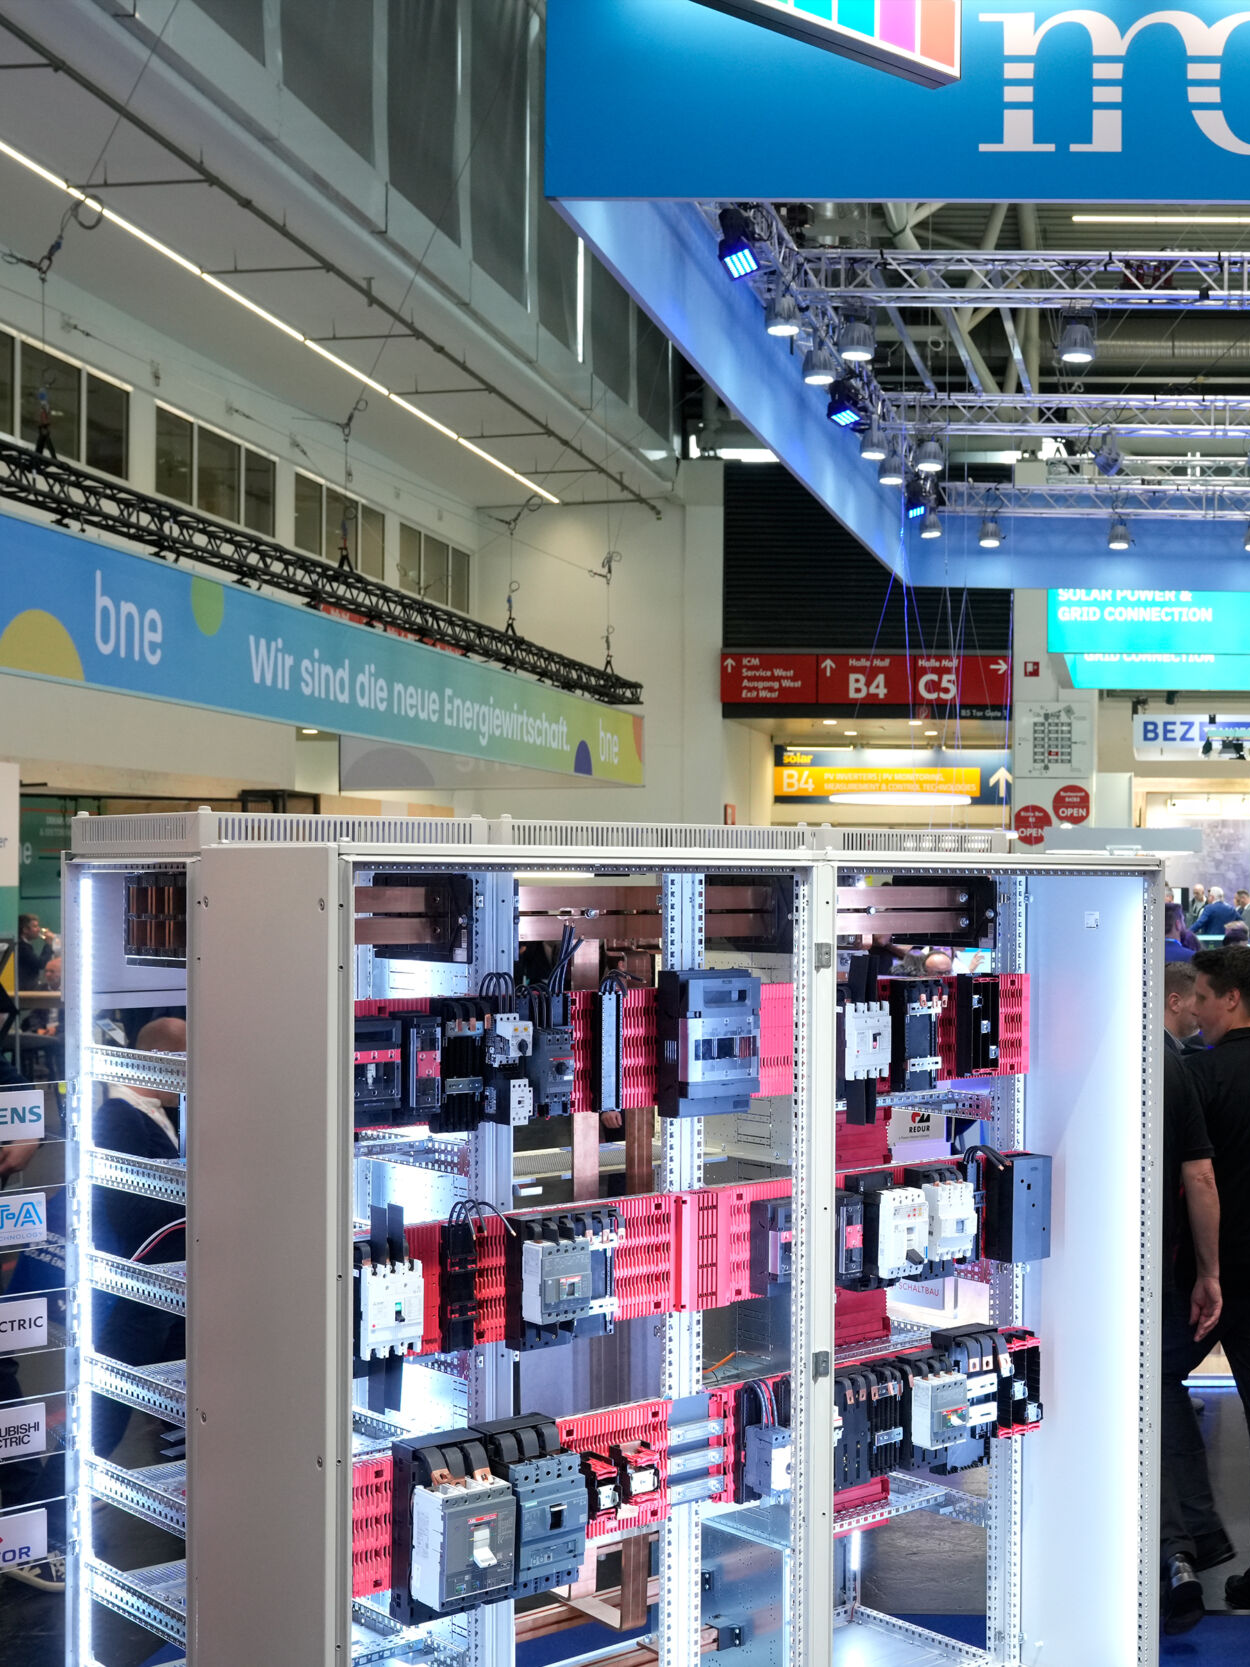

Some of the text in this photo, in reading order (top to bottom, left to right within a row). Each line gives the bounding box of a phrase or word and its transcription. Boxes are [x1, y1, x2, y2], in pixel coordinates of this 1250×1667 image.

[1058, 588, 1112, 602] SOLAR
[1116, 590, 1176, 602] POWER
[94, 570, 163, 665] bne
[1058, 606, 1213, 622] GRID CONNECTION
[742, 658, 760, 666] ICM
[849, 658, 890, 667] Halle Hall
[918, 659, 959, 667] Halle Hall
[742, 668, 794, 677] Service West
[742, 679, 802, 689] Ausgang West
[849, 674, 888, 699] B4
[918, 673, 957, 700] C5
[249, 635, 571, 752] Wir sind die neue Energiewirtschaft.
[742, 689, 779, 698] Exit West
[1142, 721, 1195, 741] BEZ
[599, 718, 619, 765] bne
[783, 752, 814, 764] solar
[783, 770, 814, 792] B4
[824, 773, 835, 781] PV
[836, 773, 877, 781] INVERTERS
[883, 773, 894, 781] PV
[1059, 808, 1086, 817] OPEN
[1019, 828, 1045, 837] OPEN
[909, 1125, 930, 1133] REDUR
[899, 1282, 939, 1297] SCHALTBAU
[0, 1421, 40, 1438] UBISHI
